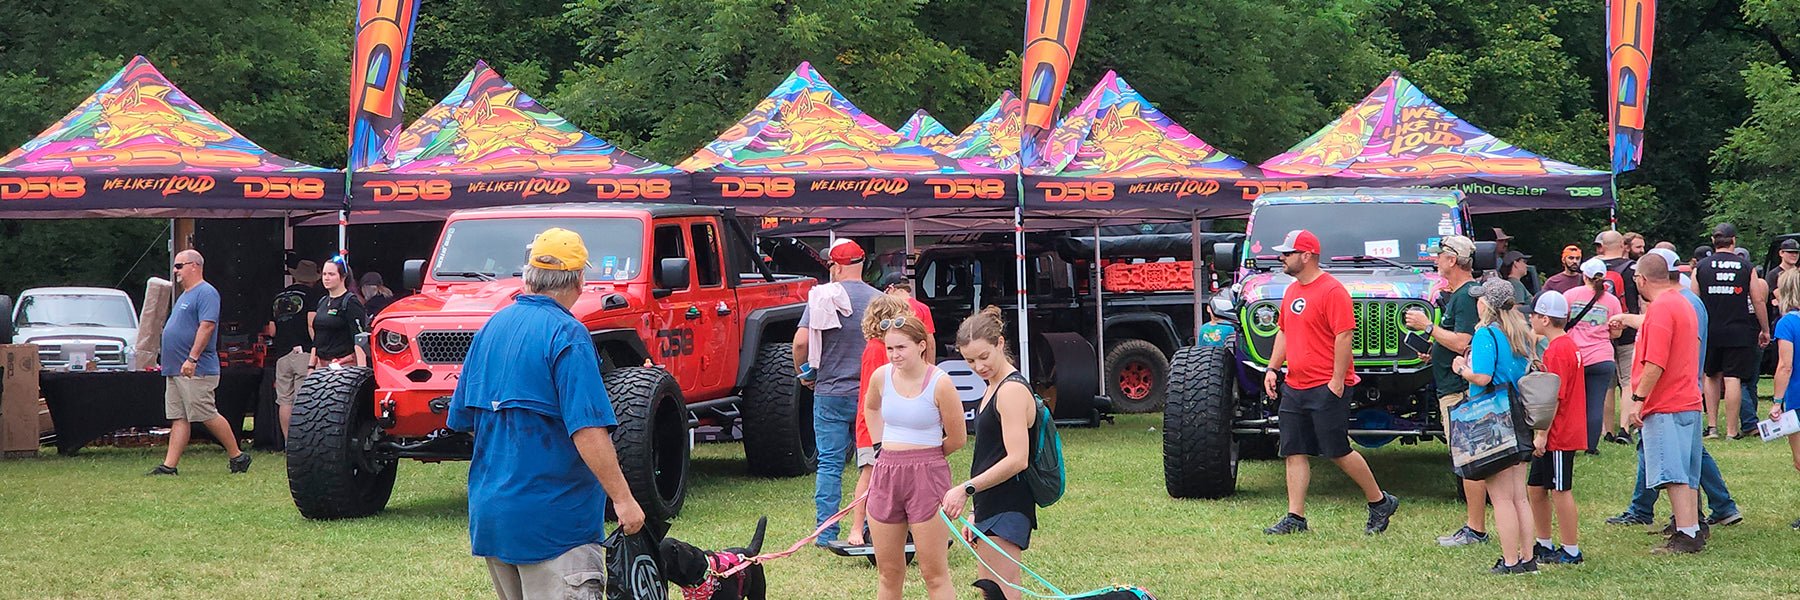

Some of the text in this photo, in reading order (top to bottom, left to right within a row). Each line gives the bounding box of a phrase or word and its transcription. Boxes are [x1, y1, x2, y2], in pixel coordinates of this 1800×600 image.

[1401, 106, 1441, 122] WE
[1382, 120, 1456, 140] LIKE IT
[1388, 130, 1465, 158] LOUD
[0, 176, 87, 200] DS18
[162, 175, 216, 198] LOUD
[233, 176, 325, 200] DS18
[363, 179, 453, 202] DS18
[521, 177, 570, 199] LOUD
[587, 178, 672, 199] DS18
[712, 176, 797, 198] DS18
[862, 177, 909, 200] LOUD
[925, 178, 1006, 200] DS18
[1036, 181, 1116, 202] DS18
[1176, 179, 1220, 200] LOUD
[1462, 183, 1547, 196] Wholesaler
[1565, 186, 1604, 197] DS18
[1718, 260, 1742, 270] LOVE
[1290, 297, 1307, 315] G
